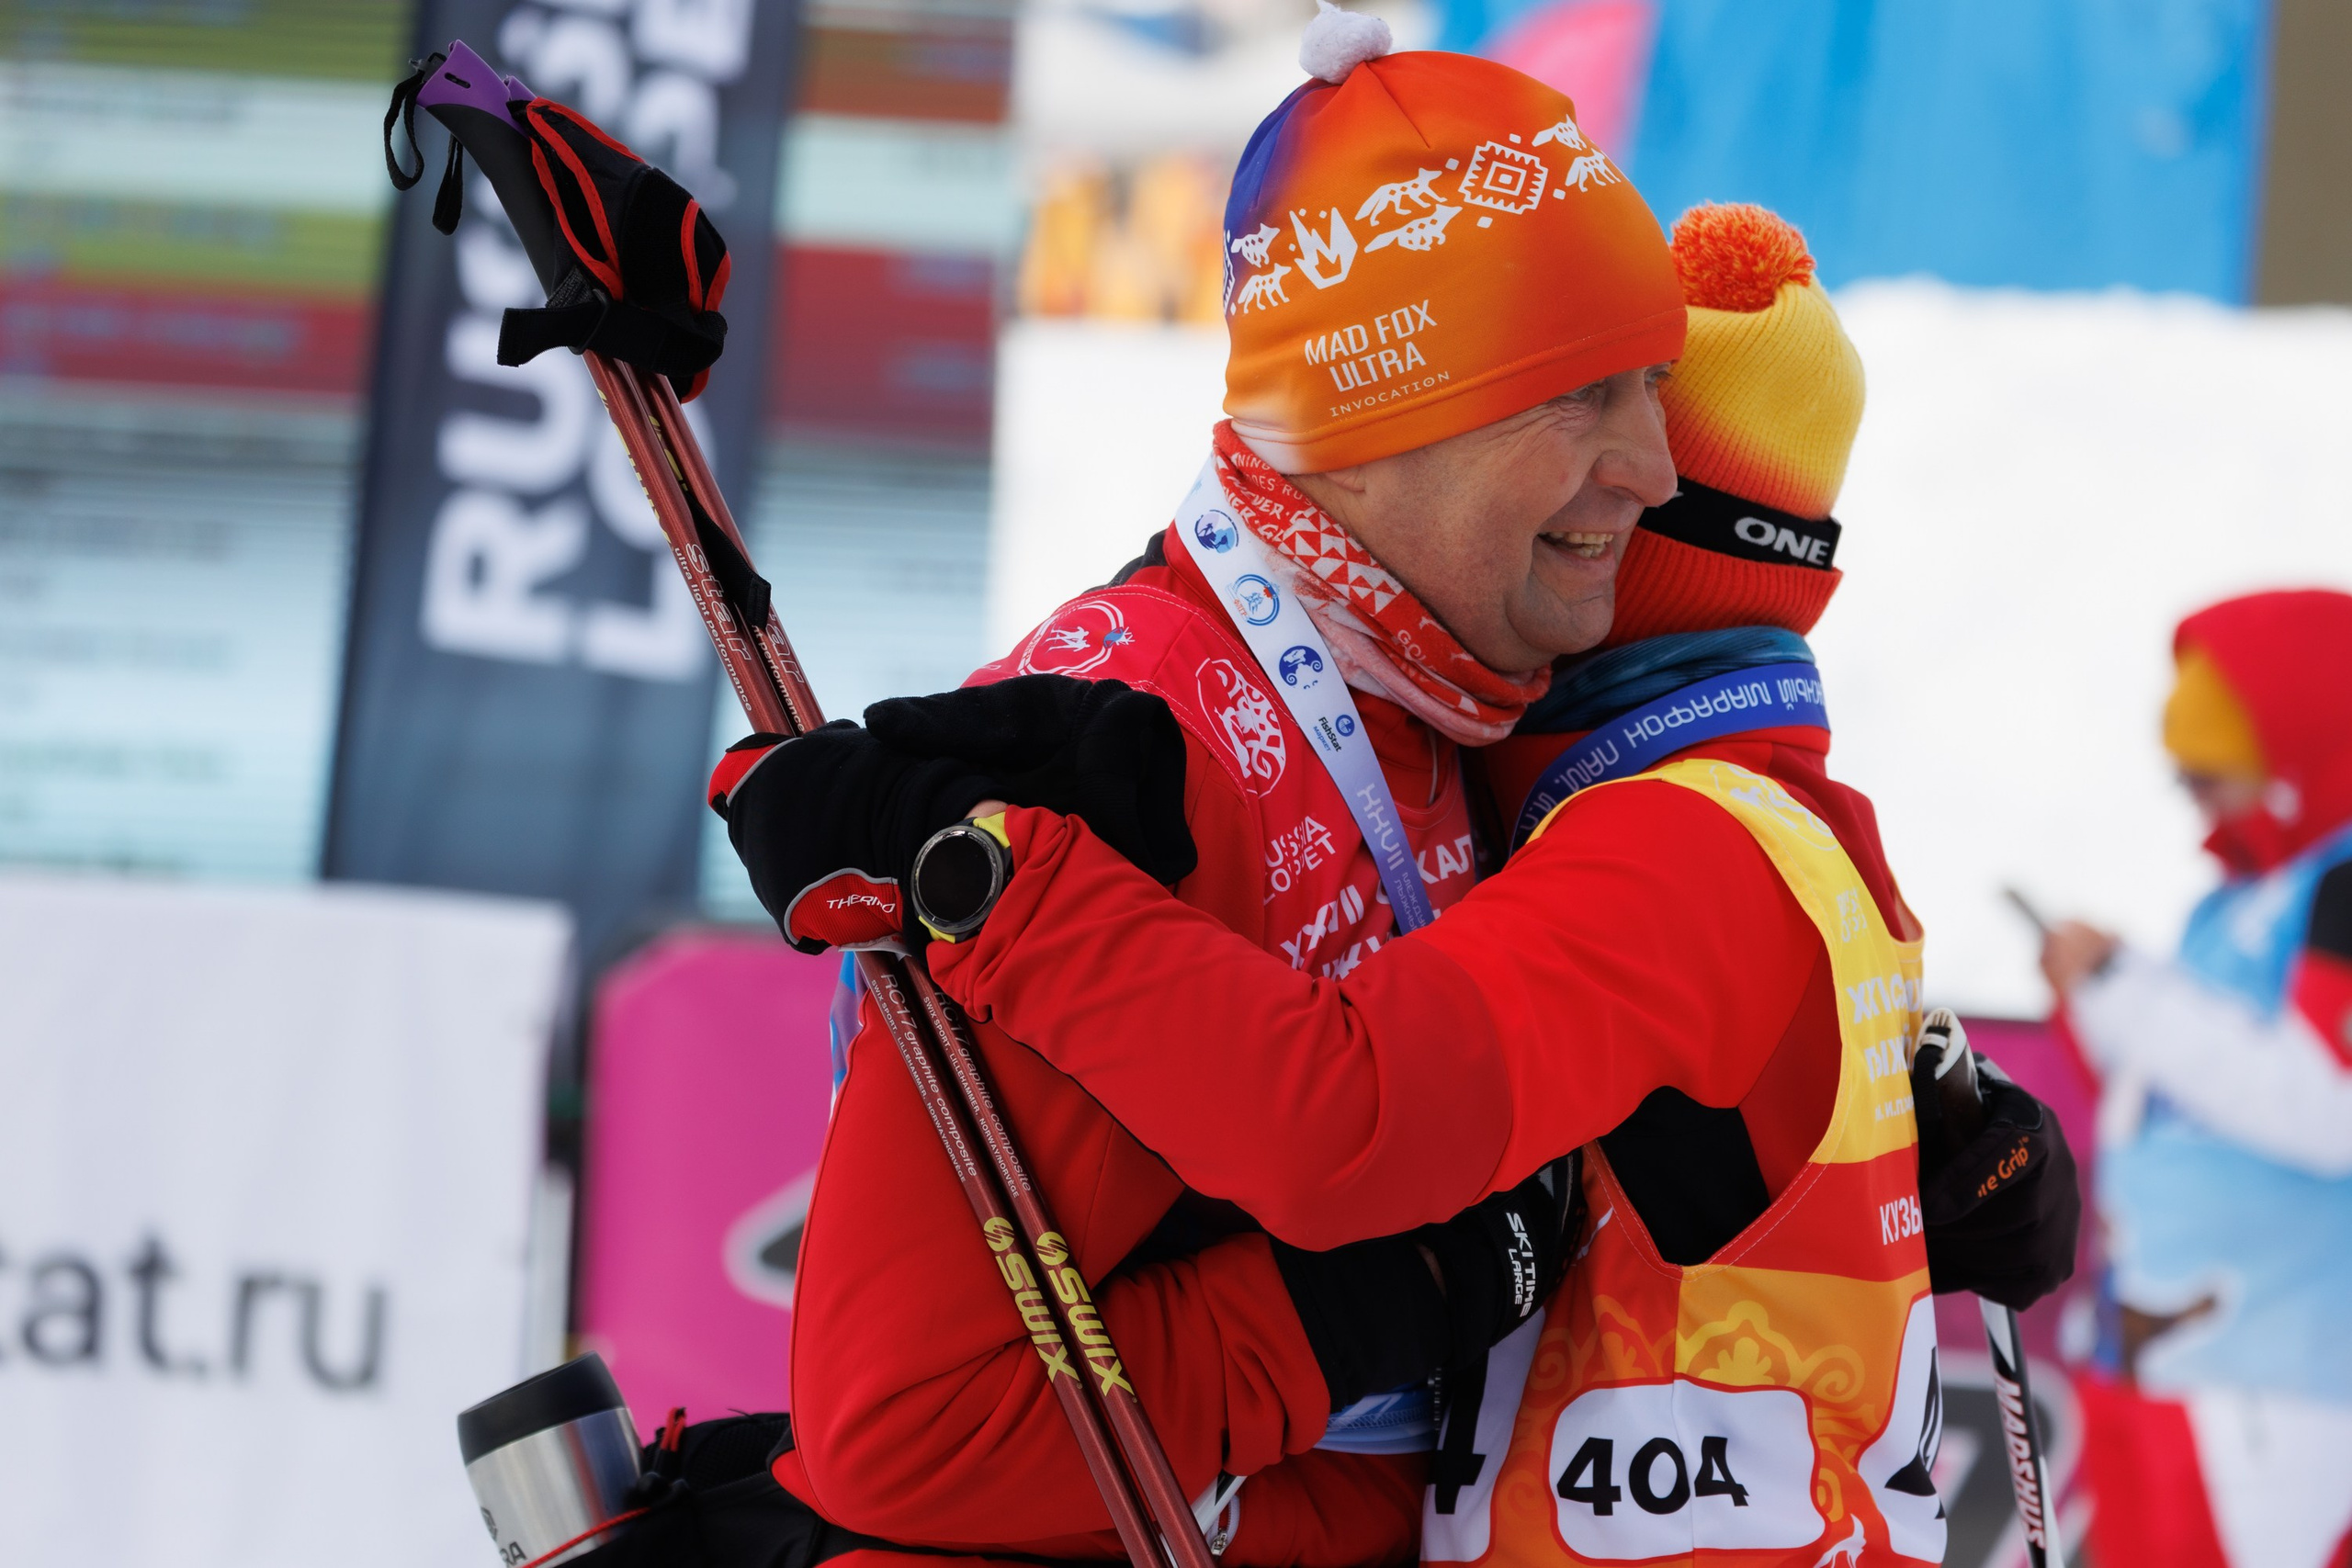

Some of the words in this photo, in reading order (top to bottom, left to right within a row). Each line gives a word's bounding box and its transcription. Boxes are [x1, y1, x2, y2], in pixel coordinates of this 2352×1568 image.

[1305, 324, 1369, 366] MAD
[1374, 299, 1438, 344] FOX
[1329, 342, 1427, 392] ULTRA
[1329, 371, 1450, 417] INVOCATION
[1735, 515, 1830, 565] ONE
[675, 547, 692, 580] ultra
[691, 583, 710, 616] light
[707, 620, 752, 711] performance
[758, 641, 805, 732] performance
[1623, 682, 1772, 749] МАРАФОН
[1313, 725, 1331, 751] маркет
[1318, 716, 1341, 753] FishStat
[871, 979, 884, 1001] SWIX
[923, 996, 937, 1019] SWIX
[881, 974, 917, 1029] RC17
[904, 1031, 939, 1093] graphite
[937, 1098, 977, 1176] composite
[958, 1047, 993, 1110] graphite
[990, 1113, 1031, 1191] composite
[1998, 1146, 2030, 1180] Grip
[1506, 1212, 1534, 1258] SKI
[1520, 1261, 1536, 1317] TIME
[1508, 1248, 1523, 1304] LARGE
[0, 1227, 388, 1394] at.ru
[996, 1253, 1080, 1383] SWIX
[1047, 1268, 1136, 1397] SWIX
[1556, 1436, 1749, 1516] 404
[1995, 1378, 2047, 1550] MADSHUS
